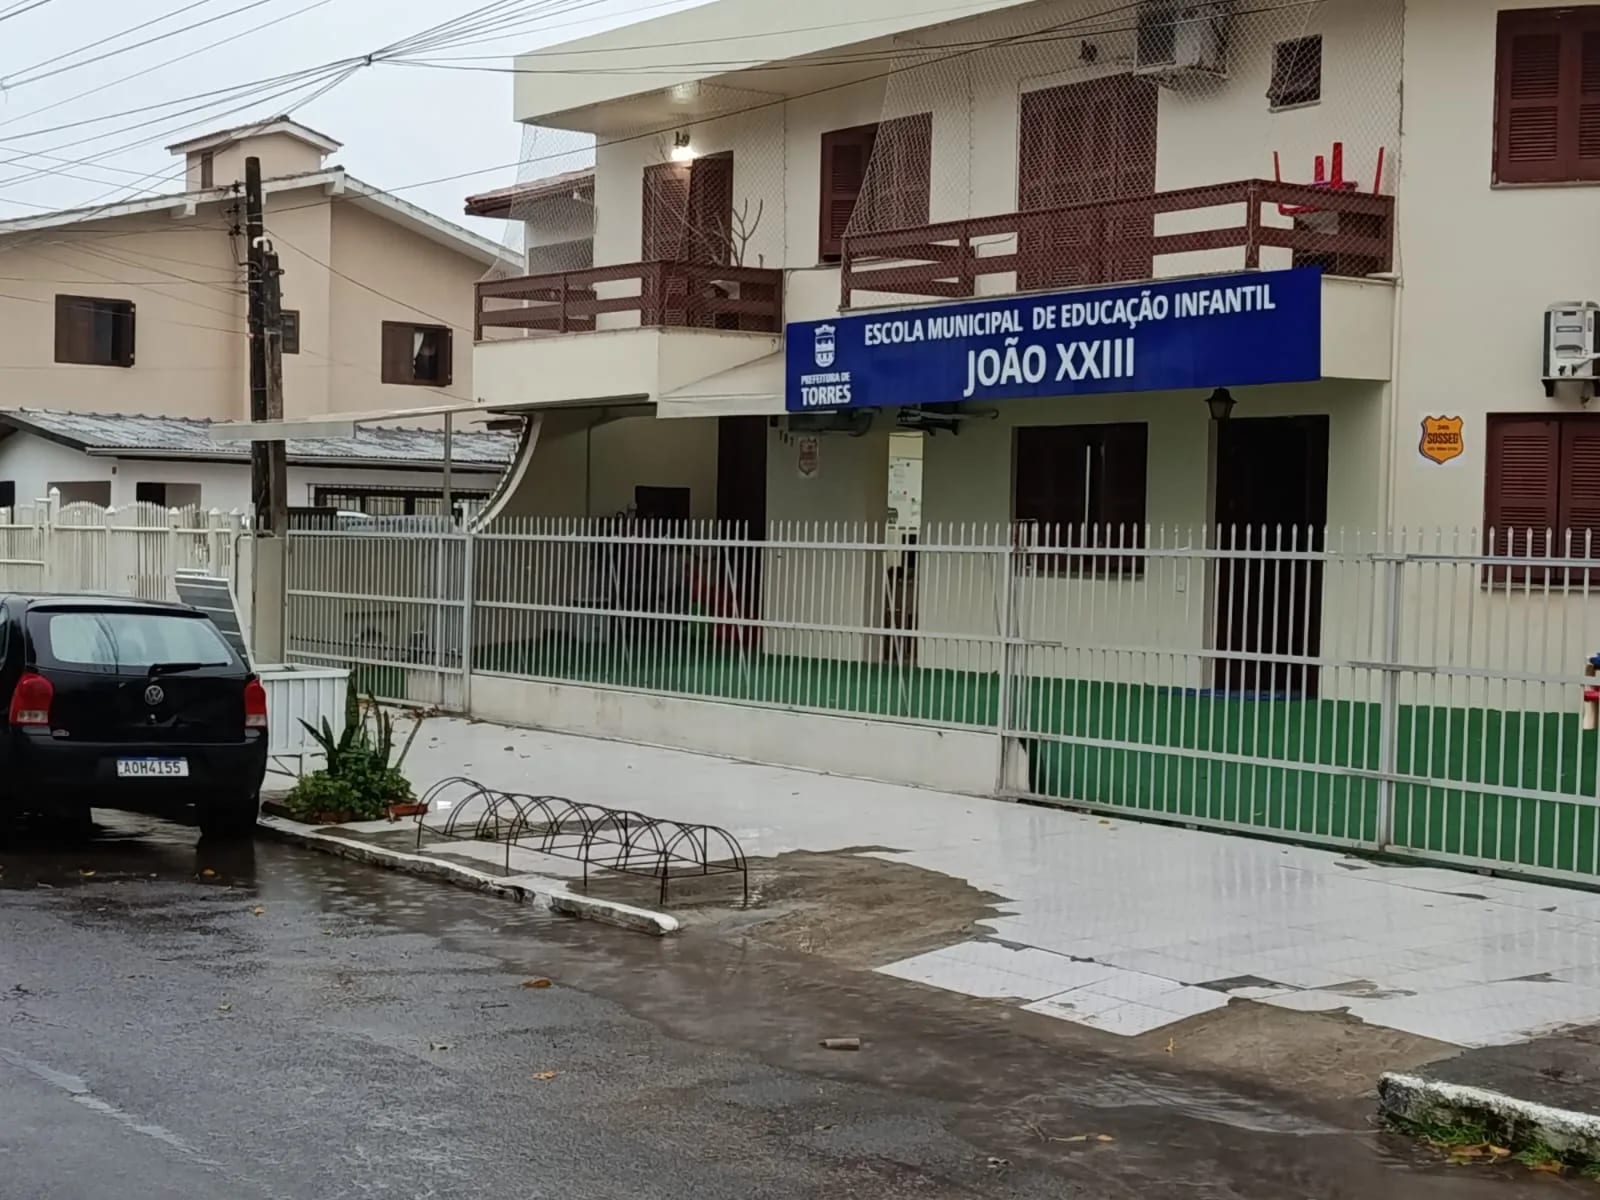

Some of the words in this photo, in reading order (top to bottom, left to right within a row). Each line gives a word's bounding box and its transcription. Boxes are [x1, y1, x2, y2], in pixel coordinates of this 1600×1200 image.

[864, 319, 924, 346] ESCOLA
[927, 309, 1023, 340] MUNICIPAL
[1032, 305, 1056, 331] DE
[1060, 290, 1169, 329] EDUCAÇÃO
[1174, 284, 1276, 318] INFANTIL
[801, 373, 841, 385] PREFEITURA
[841, 371, 851, 382] DE
[963, 336, 1047, 398] JOÃO
[1054, 337, 1134, 382] XXIII
[801, 384, 851, 406] TORRES
